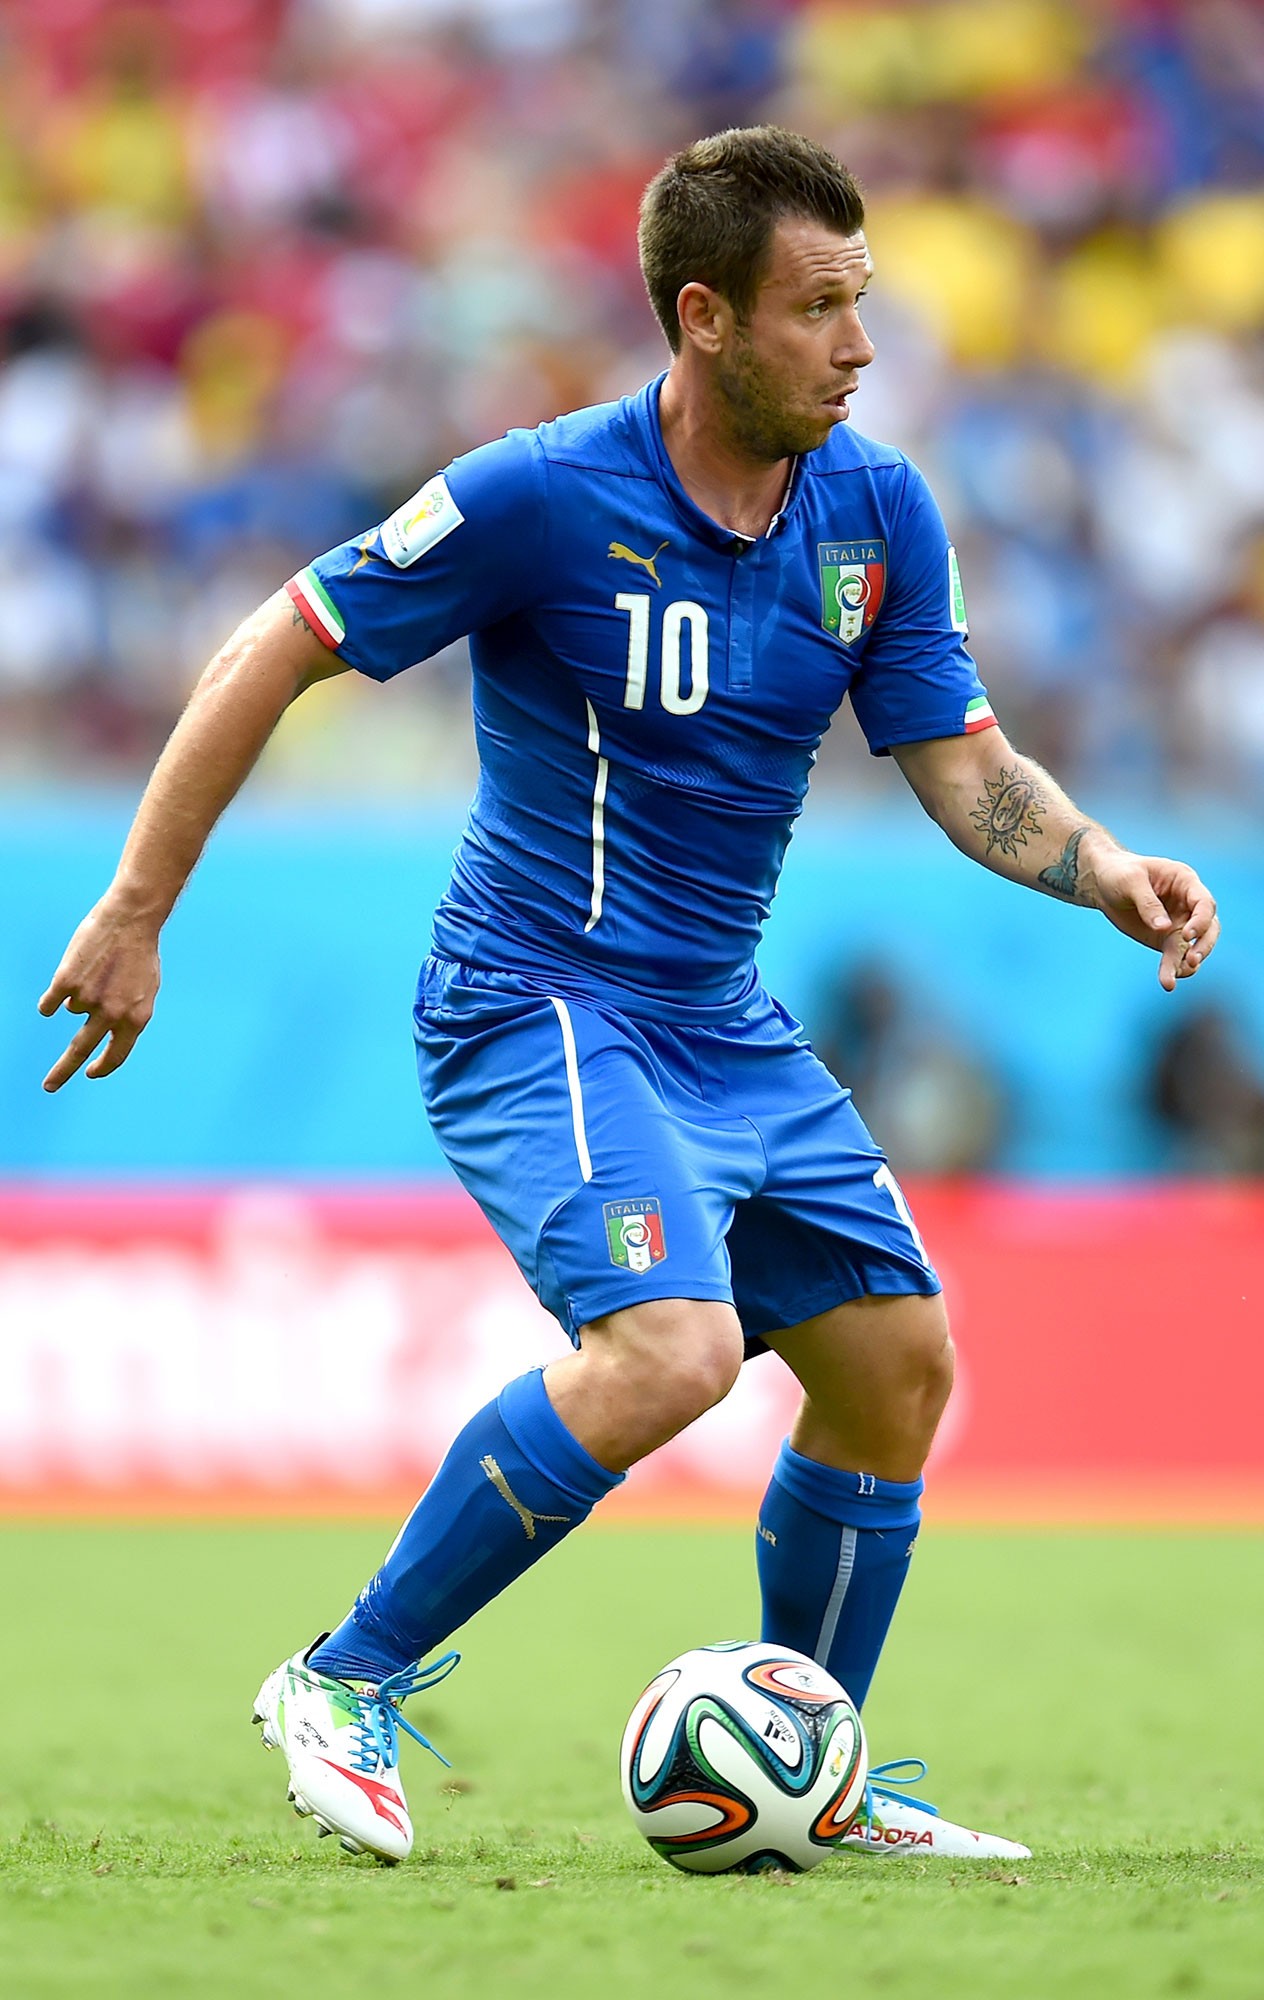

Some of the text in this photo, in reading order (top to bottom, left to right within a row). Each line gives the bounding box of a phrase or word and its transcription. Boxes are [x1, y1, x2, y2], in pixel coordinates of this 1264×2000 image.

[825, 547, 877, 563] ITALIA
[614, 592, 710, 716] 10
[610, 1203, 653, 1216] ITALIA
[770, 1710, 796, 1743] adidas
